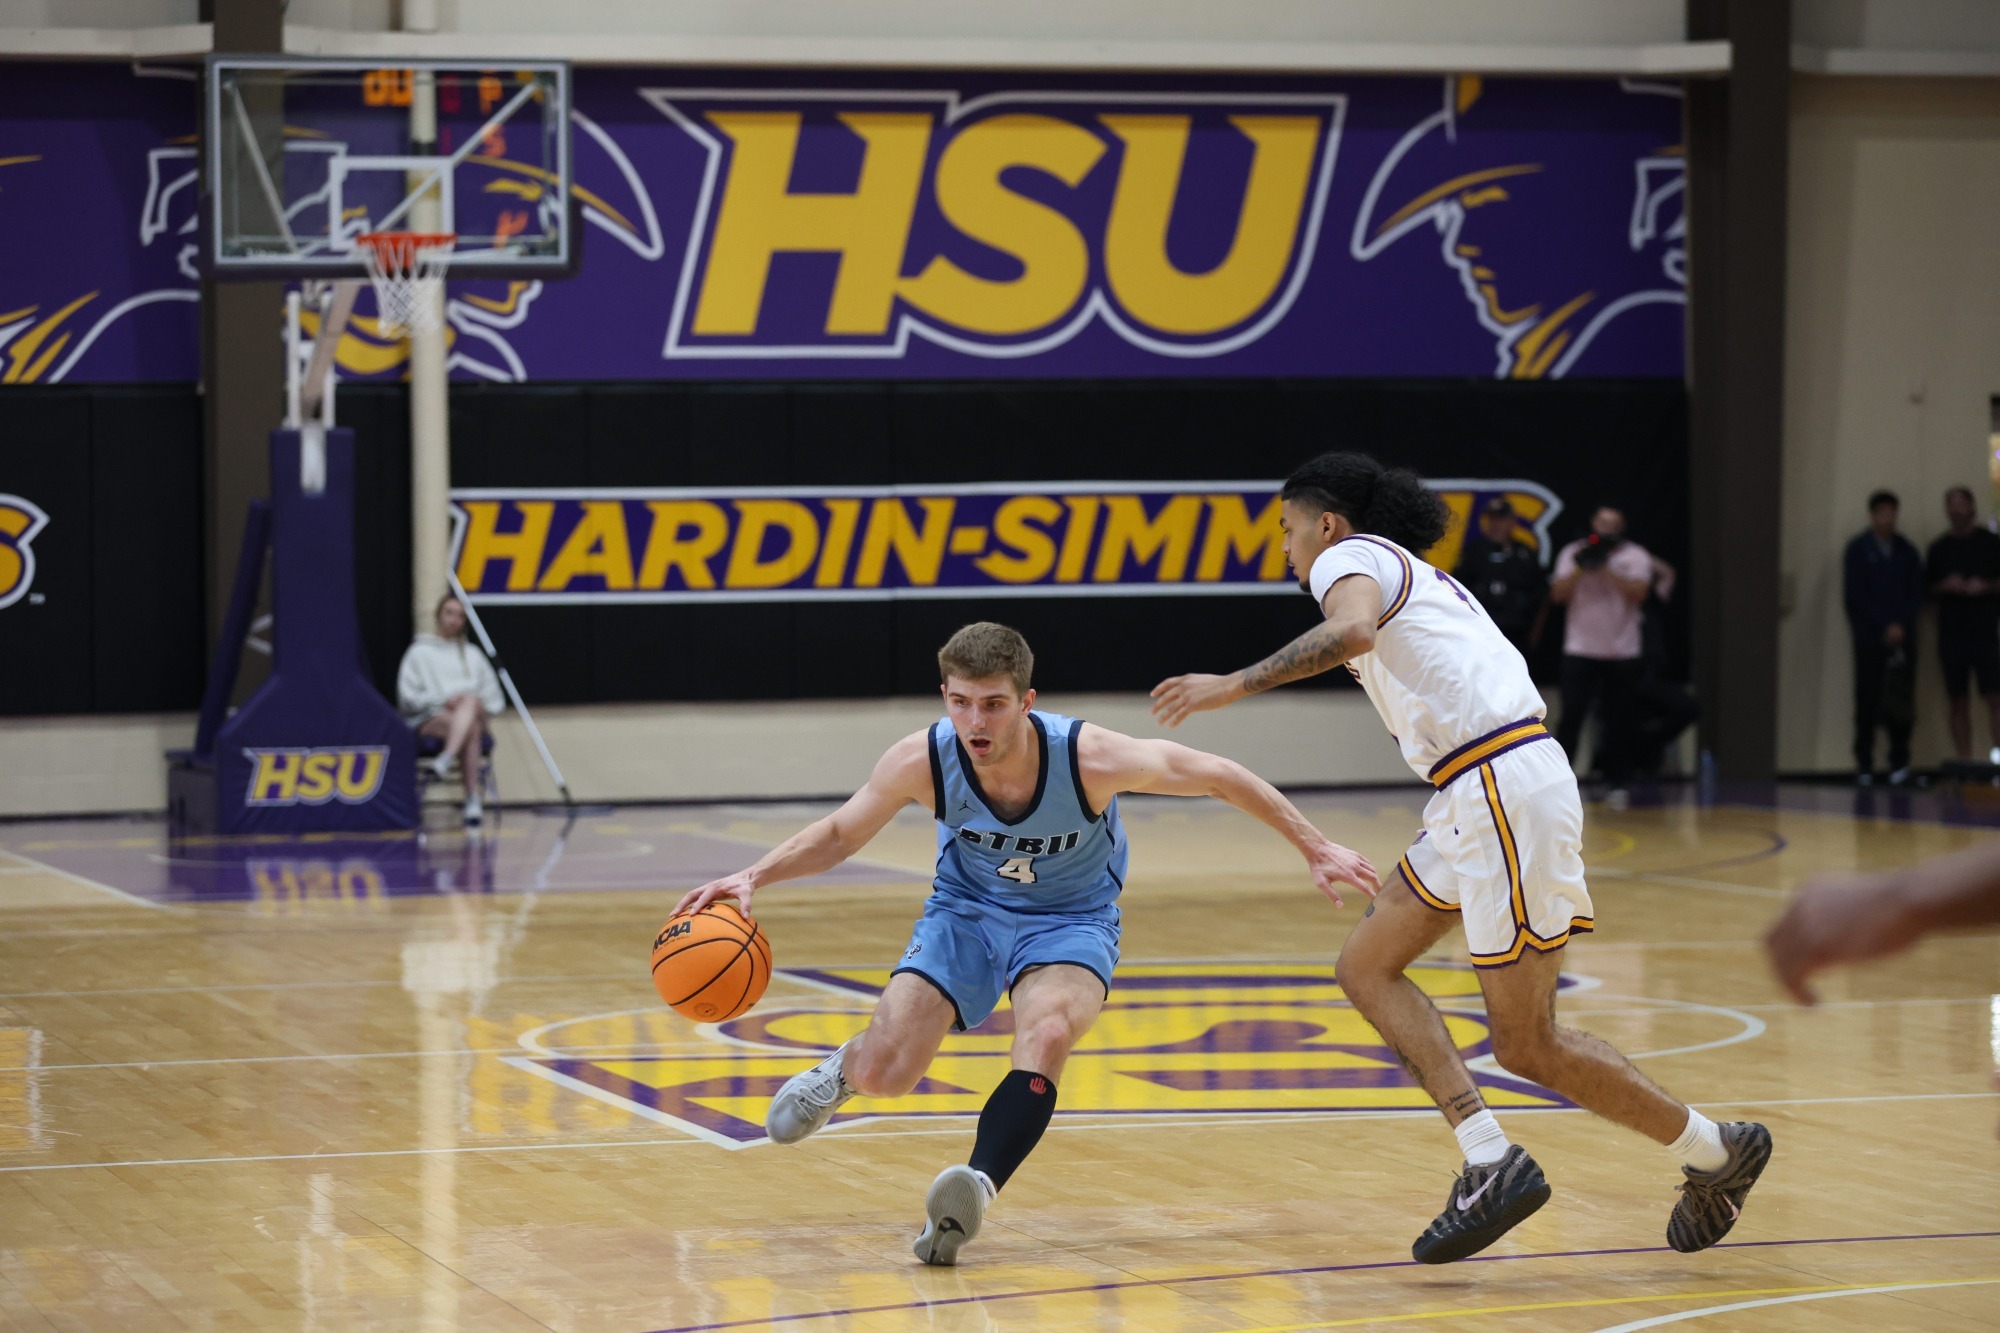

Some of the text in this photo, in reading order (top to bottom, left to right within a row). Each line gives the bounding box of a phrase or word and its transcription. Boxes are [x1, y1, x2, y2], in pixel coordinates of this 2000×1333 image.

[691, 110, 1322, 337] HSU
[457, 491, 1548, 591] HARDIN-SIMM
[253, 751, 383, 799] HSU
[996, 857, 1038, 884] 4
[653, 920, 692, 950] NCAA
